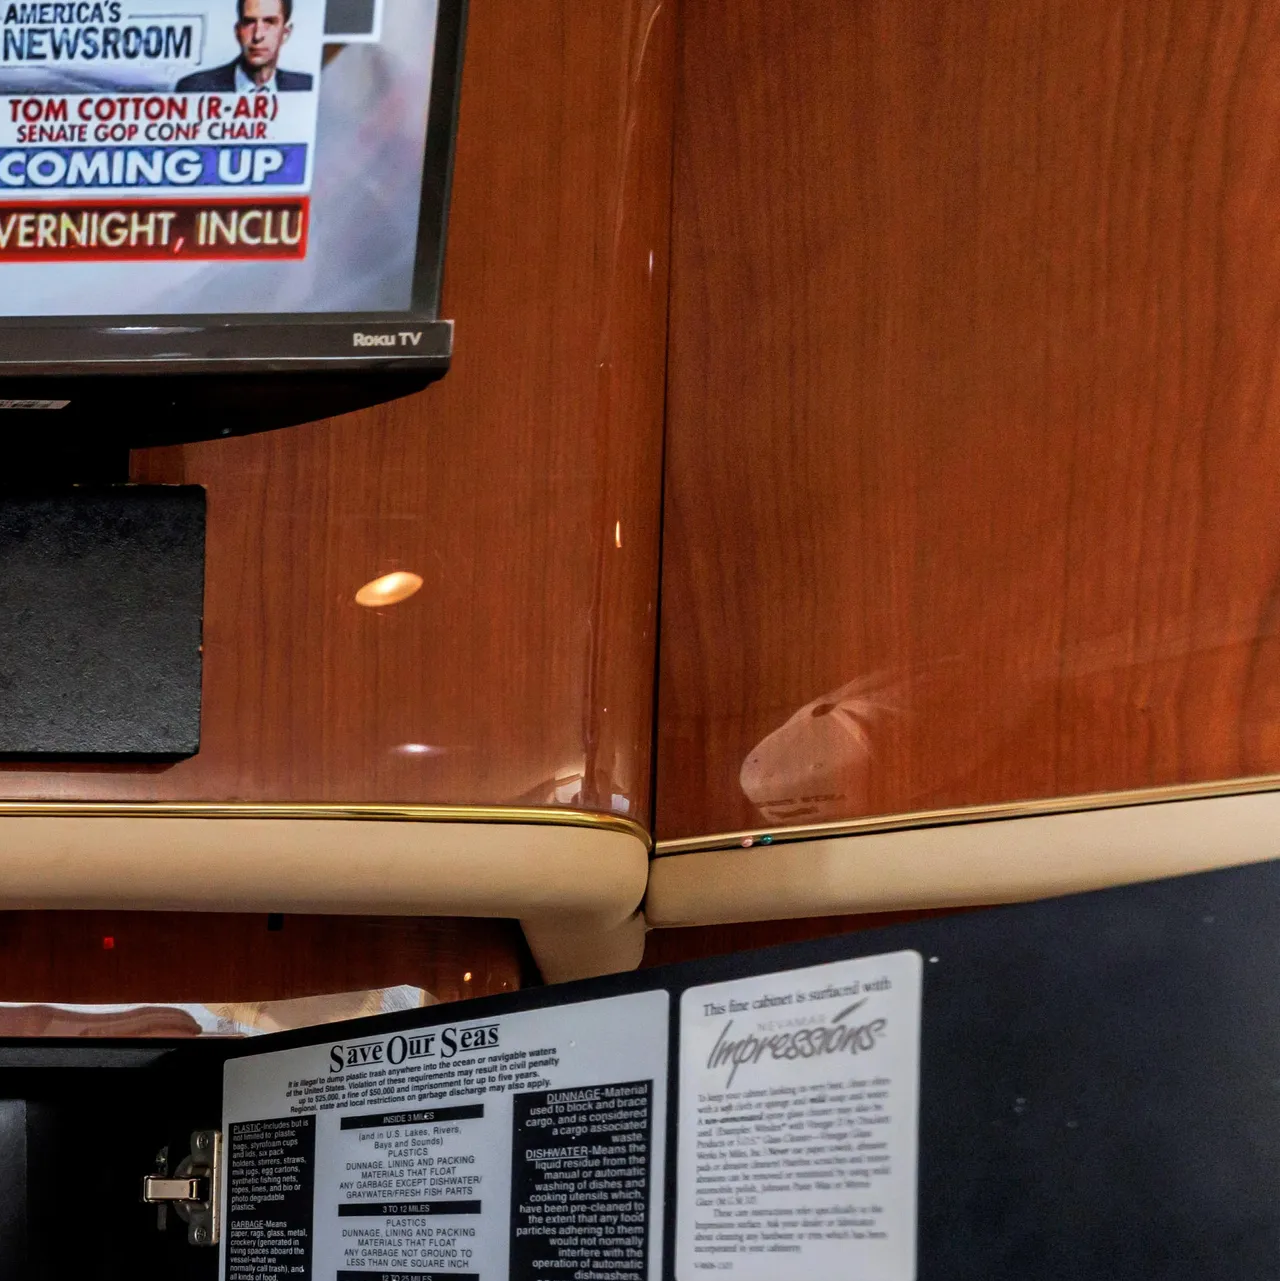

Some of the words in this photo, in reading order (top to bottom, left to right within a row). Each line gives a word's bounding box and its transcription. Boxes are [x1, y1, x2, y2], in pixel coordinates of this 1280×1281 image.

[3, 0, 122, 24] AMERICA'S
[3, 26, 193, 61] NEWSROOM
[9, 99, 68, 123] TOM
[78, 97, 187, 122] COTTON
[197, 94, 278, 122] (R-AR)
[16, 123, 87, 142] SENATE
[94, 123, 139, 142] GOP
[144, 122, 202, 142] CONF
[207, 121, 267, 141] CHAIR
[219, 147, 284, 185] UP
[199, 210, 303, 246] INCLU
[398, 331, 422, 346] TV
[329, 1041, 384, 1074] Save
[386, 1034, 436, 1065] Our
[440, 1024, 500, 1058] Seas
[383, 1114, 406, 1124] INSIDE
[406, 1113, 413, 1123] 3
[412, 1111, 436, 1122] MILES
[388, 1148, 428, 1158] PLASTICS
[361, 1169, 404, 1179] MATERIALS
[406, 1167, 428, 1178] THAT
[430, 1166, 456, 1176] FLOAT
